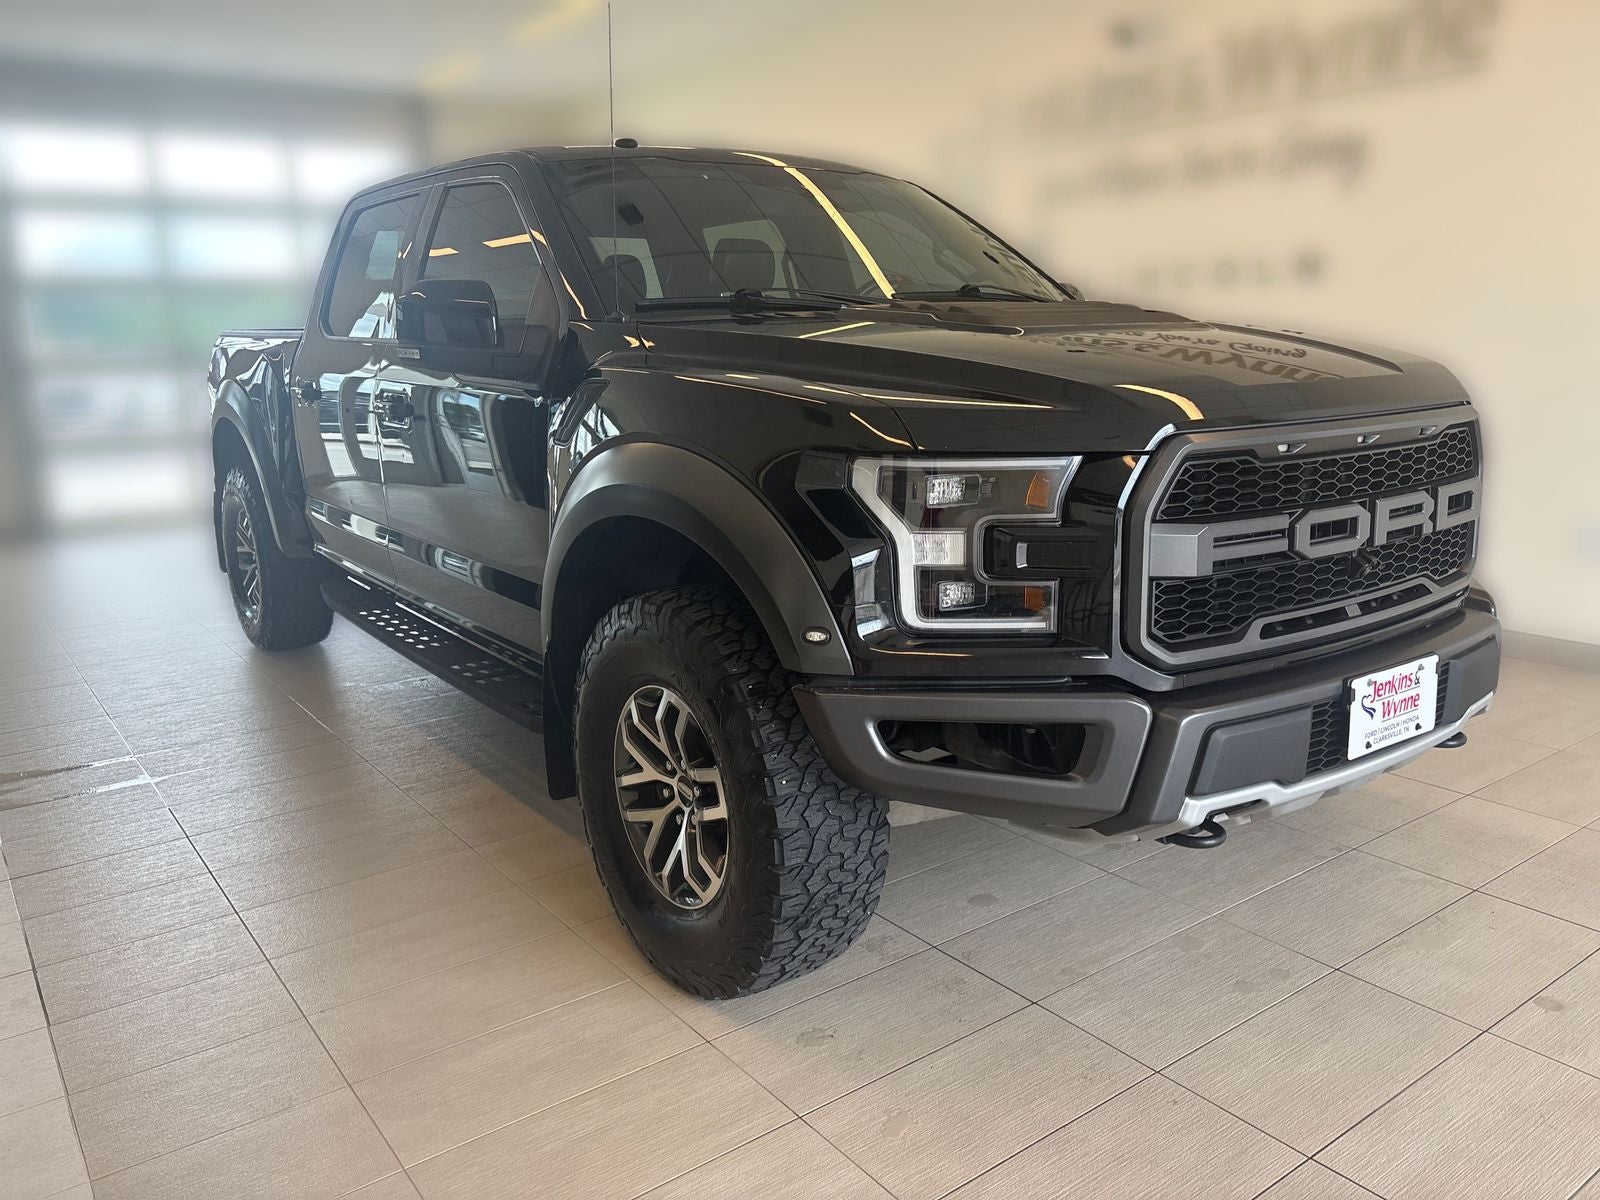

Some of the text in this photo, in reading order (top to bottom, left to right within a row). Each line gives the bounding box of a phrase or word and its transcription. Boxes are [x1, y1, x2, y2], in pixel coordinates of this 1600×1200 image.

[1150, 478, 1481, 577] FORD
[1370, 672, 1413, 704] Jenkins
[1381, 692, 1420, 719] Wynne
[1364, 715, 1420, 740] FORD LINCOLN HONDA
